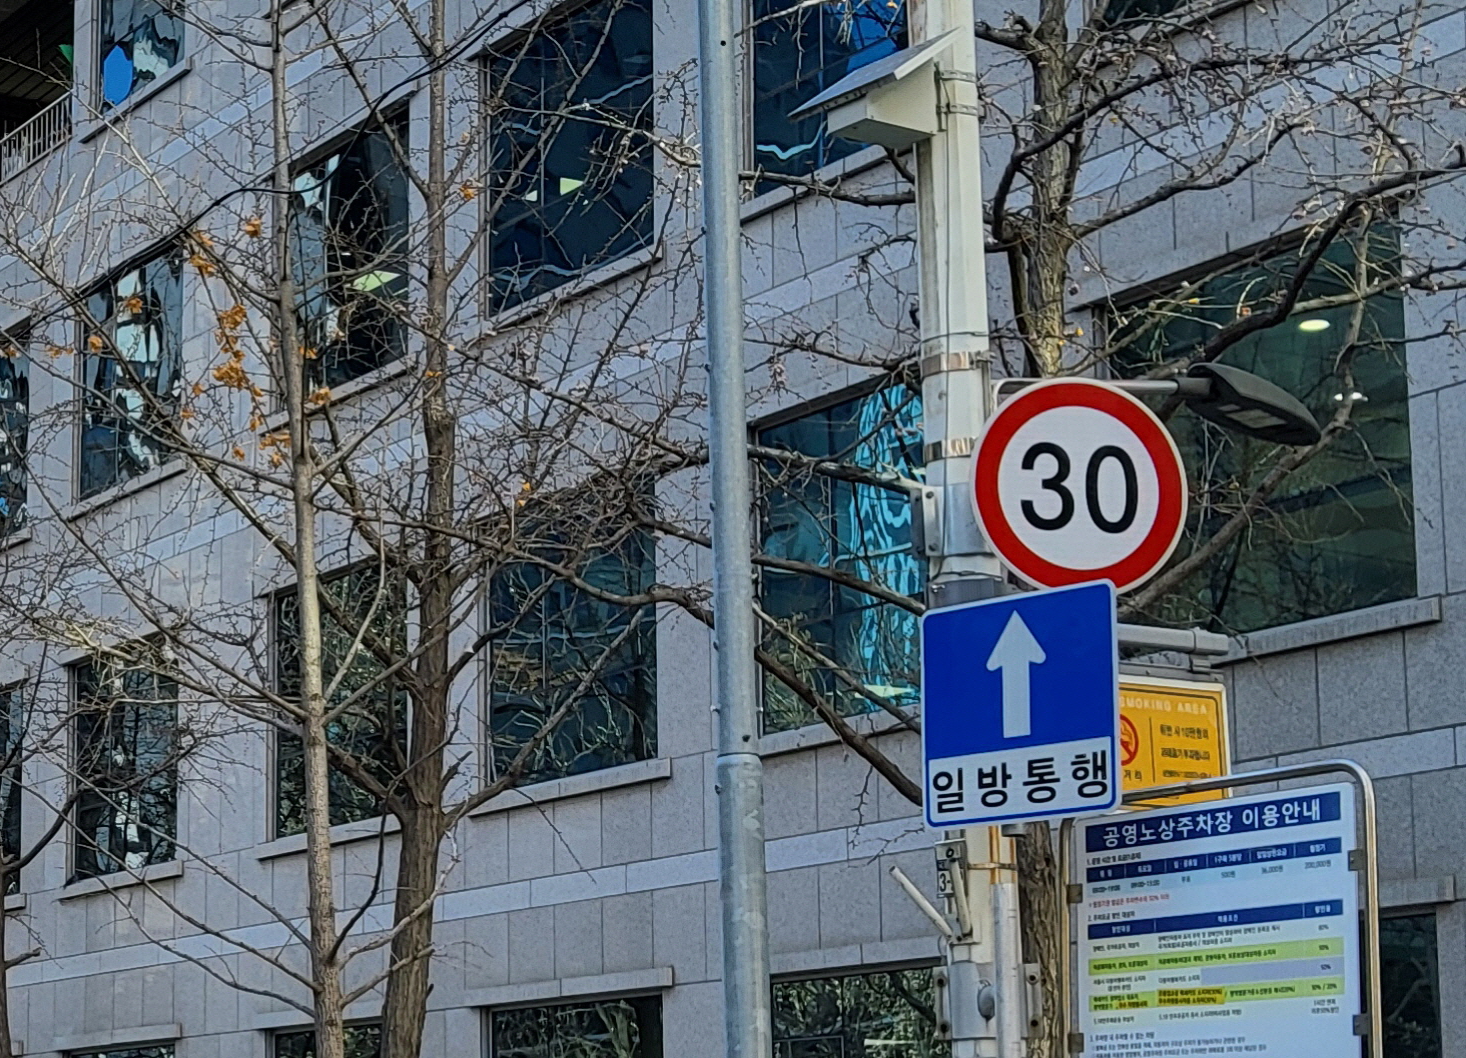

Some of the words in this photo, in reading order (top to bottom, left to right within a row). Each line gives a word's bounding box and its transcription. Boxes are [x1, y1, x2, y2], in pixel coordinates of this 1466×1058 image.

[1020, 442, 1138, 534] 30
[1177, 702, 1207, 715] AREA
[932, 748, 1110, 814] 일방통행
[1103, 811, 1233, 848] 공영노상주차장
[1242, 797, 1321, 829] 이용안내
